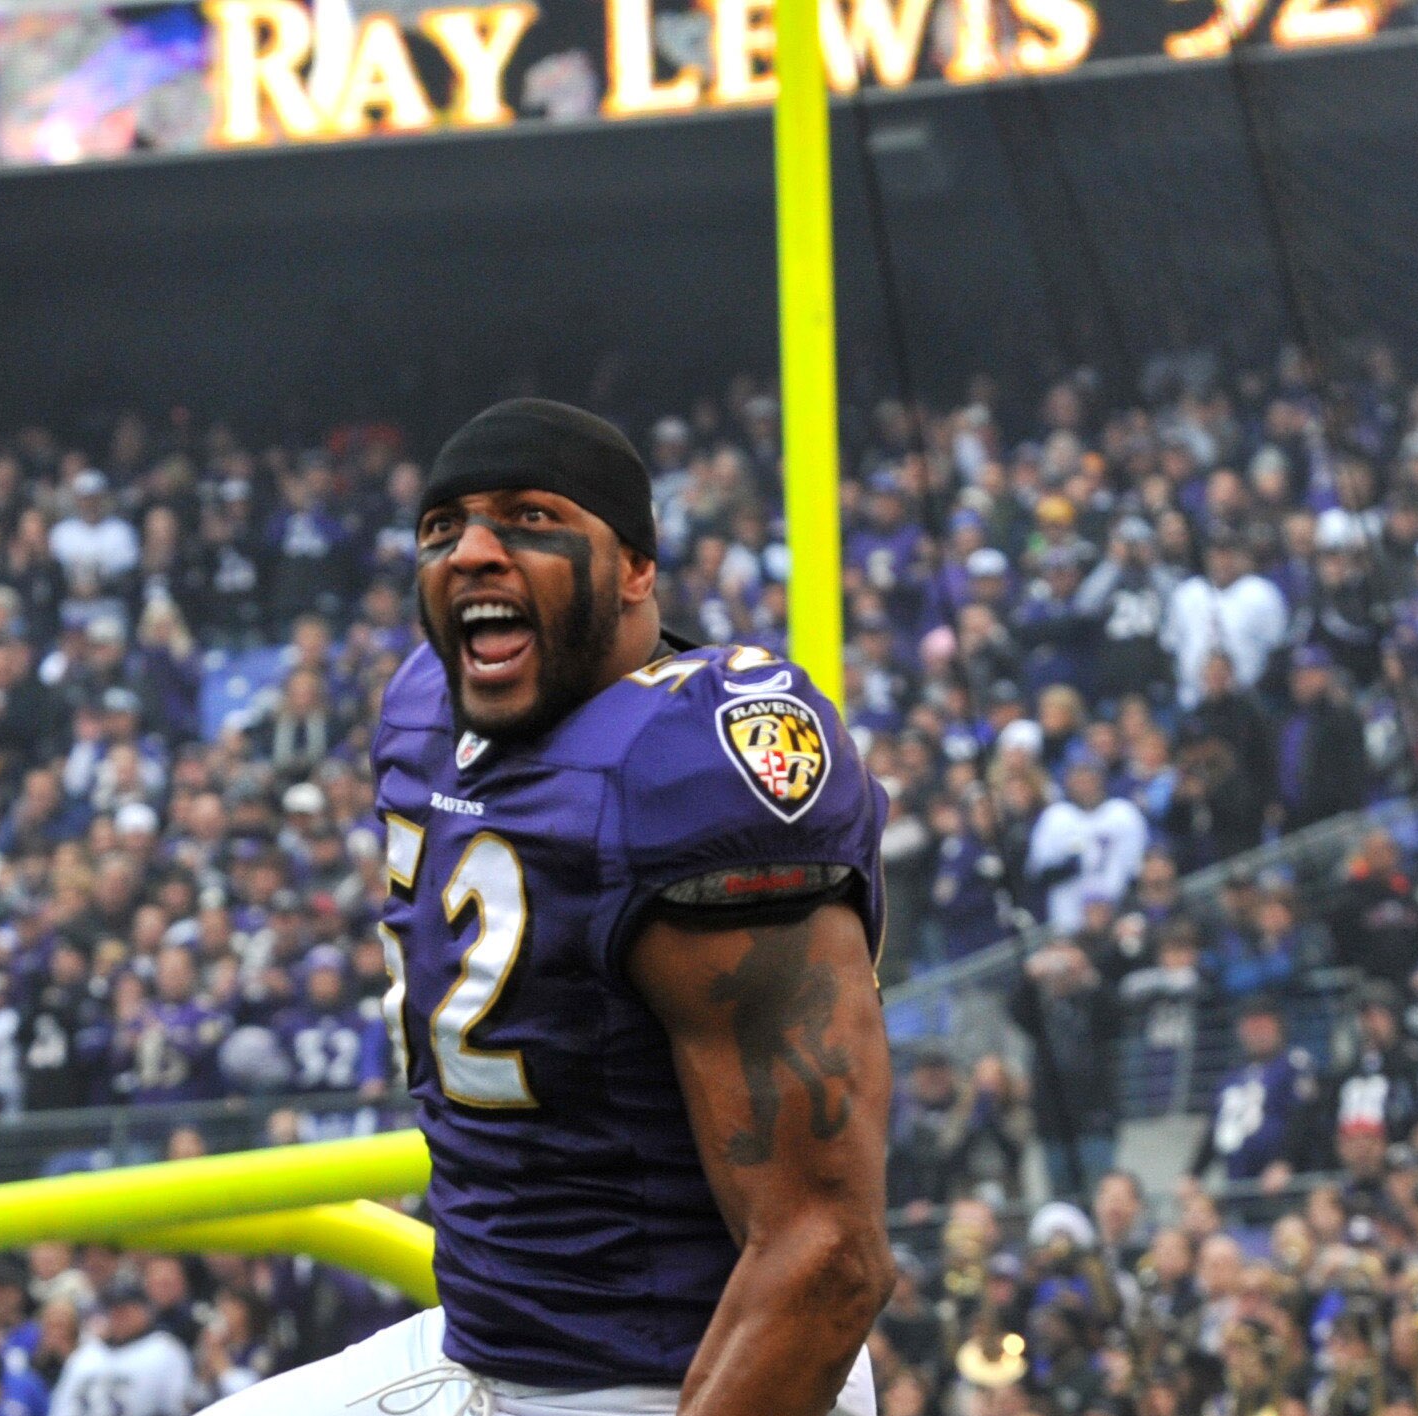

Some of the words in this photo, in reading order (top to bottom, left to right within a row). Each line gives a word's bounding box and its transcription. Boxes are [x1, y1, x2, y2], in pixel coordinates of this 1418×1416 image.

[205, 0, 538, 146] RAY
[602, 0, 1094, 117] LEWIS
[730, 701, 811, 723] RAVENS
[430, 792, 486, 816] RAVENS
